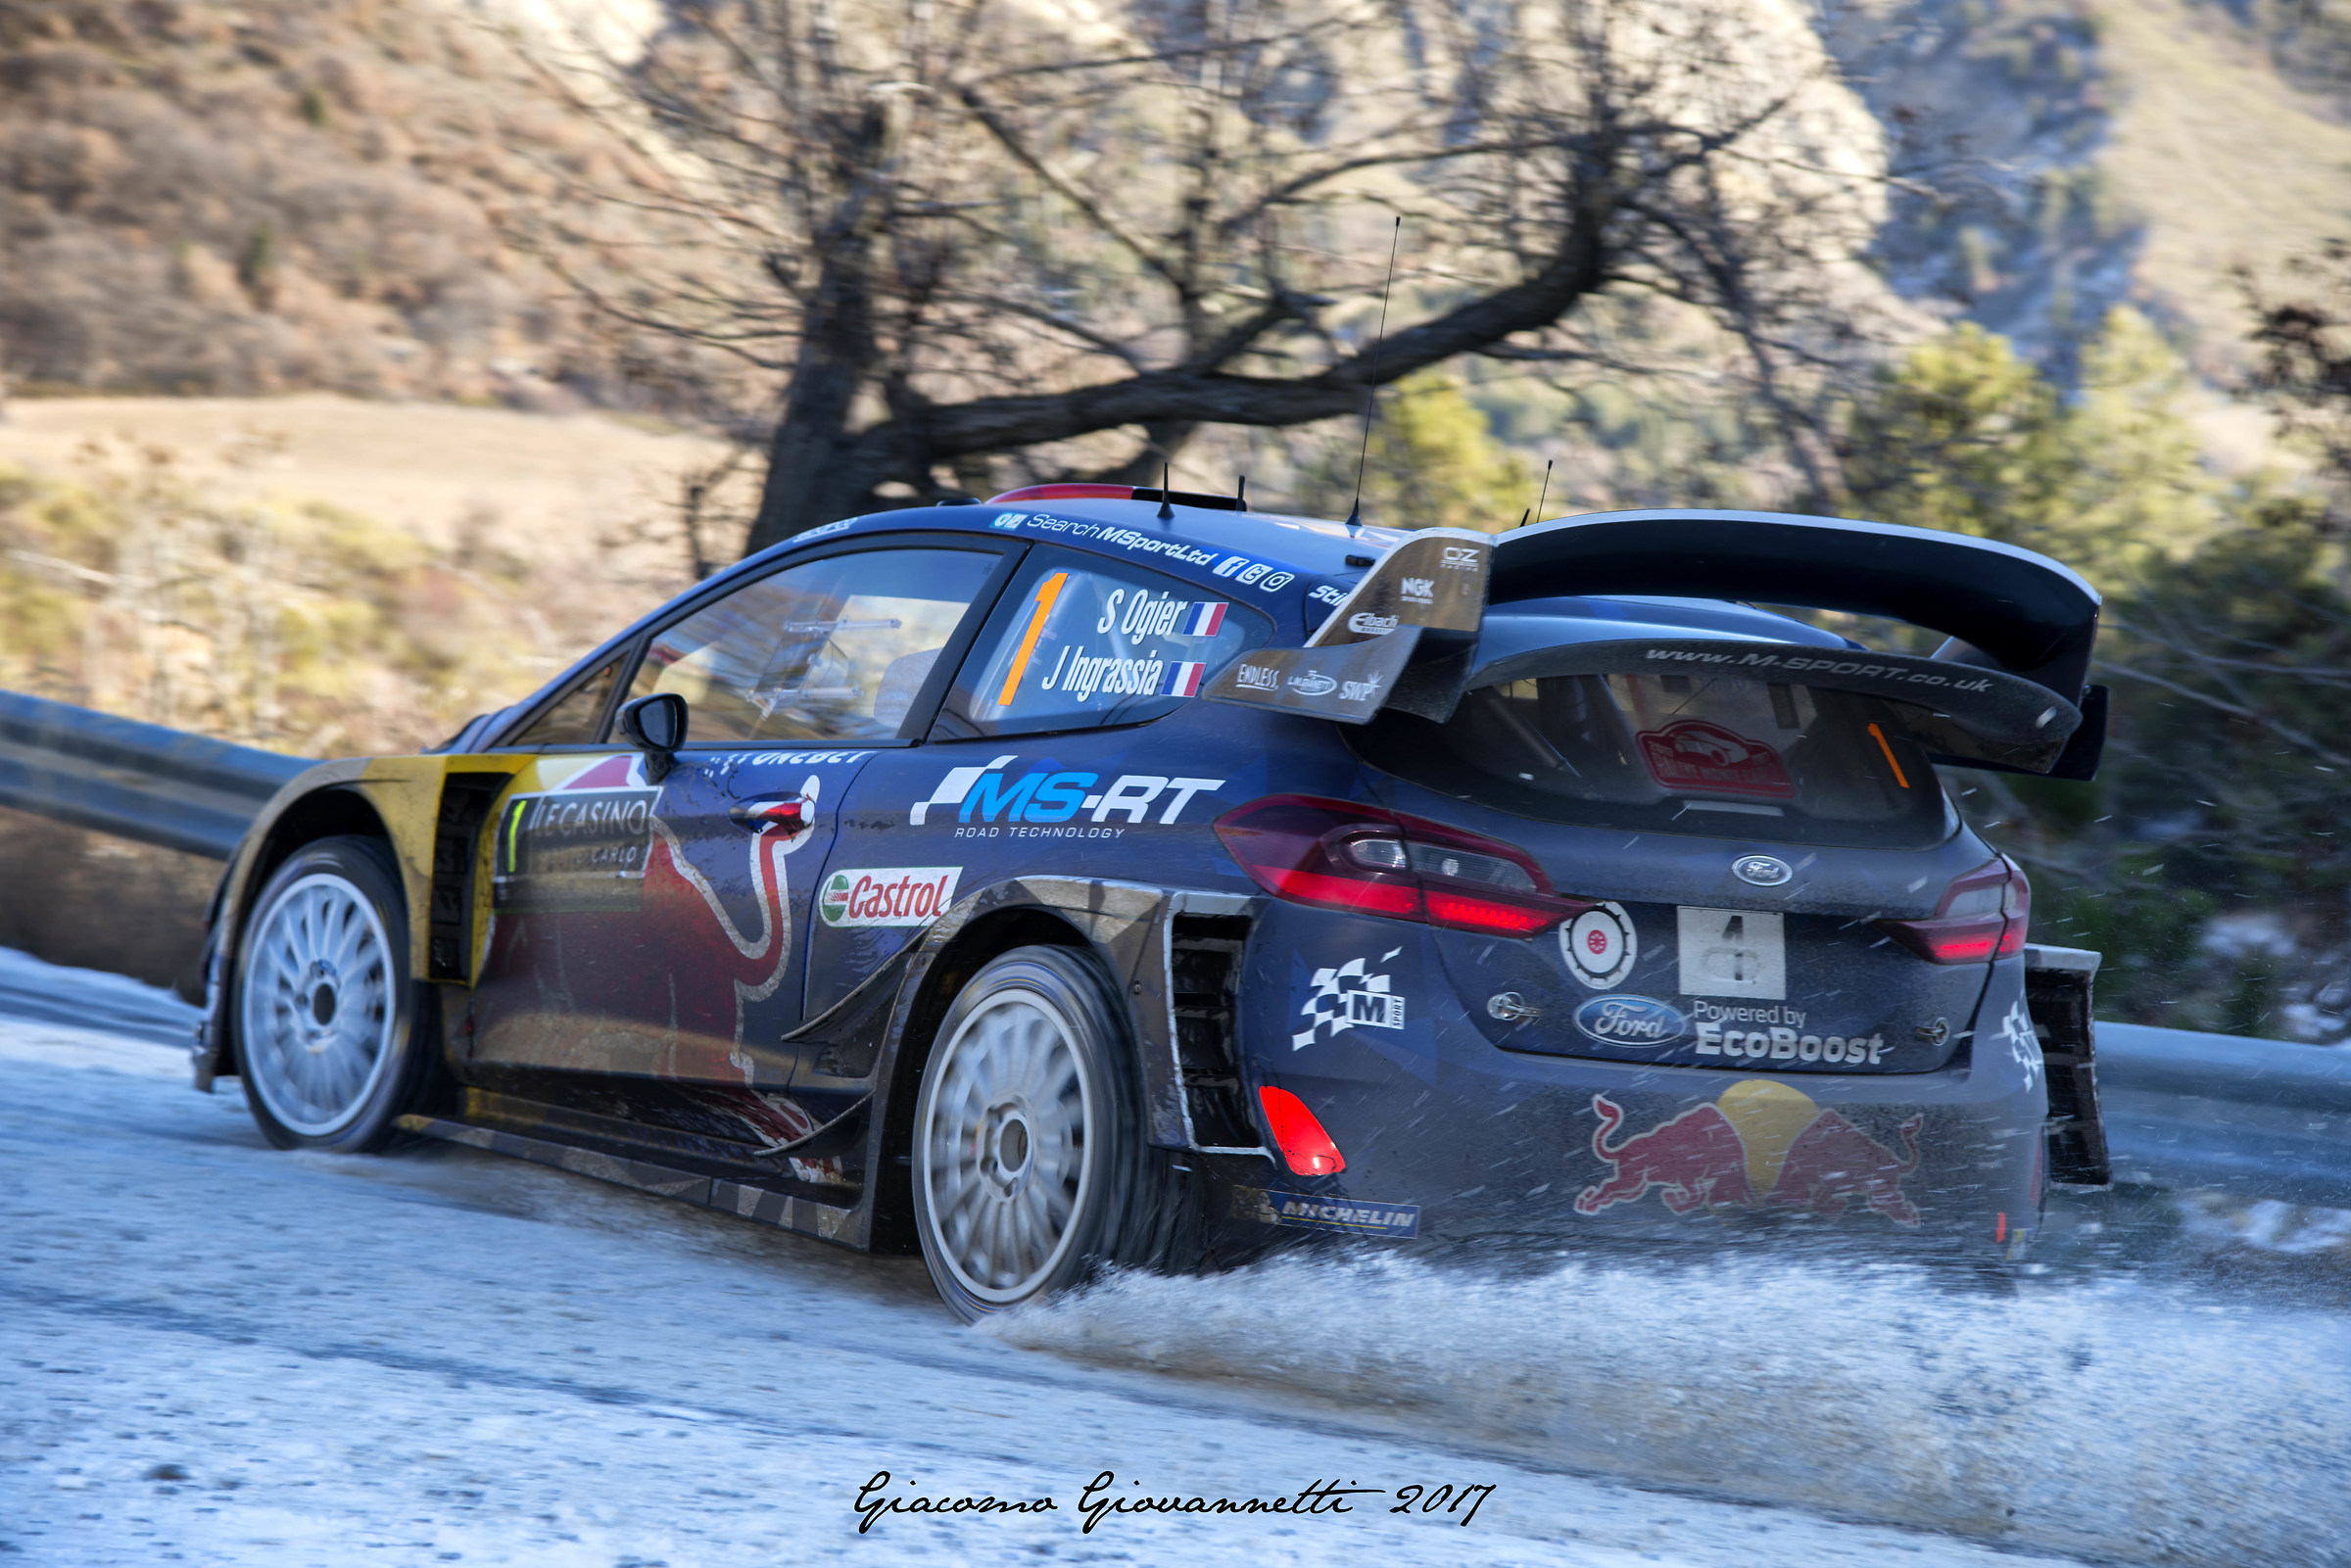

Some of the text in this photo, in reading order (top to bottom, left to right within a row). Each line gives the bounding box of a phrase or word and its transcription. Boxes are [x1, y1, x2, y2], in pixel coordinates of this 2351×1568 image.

[1400, 577, 1434, 597] NGK
[997, 573, 1069, 705] 1
[1097, 589, 1187, 645] S Ogier
[1042, 645, 1165, 702] J Ingrassia
[1647, 649, 1993, 693] www.M-SPORT.co.uk
[1867, 723, 1909, 788] 1
[959, 772, 1226, 825] MS-RT
[954, 827, 1126, 838] ROAD TECHNOLOGY
[848, 875, 948, 919] Castrol
[1596, 1001, 1666, 1038] Ford
[1693, 1000, 1806, 1028] Powered by
[1696, 1022, 1885, 1065] EcoBoost
[1281, 1201, 1415, 1227] MICHELIN
